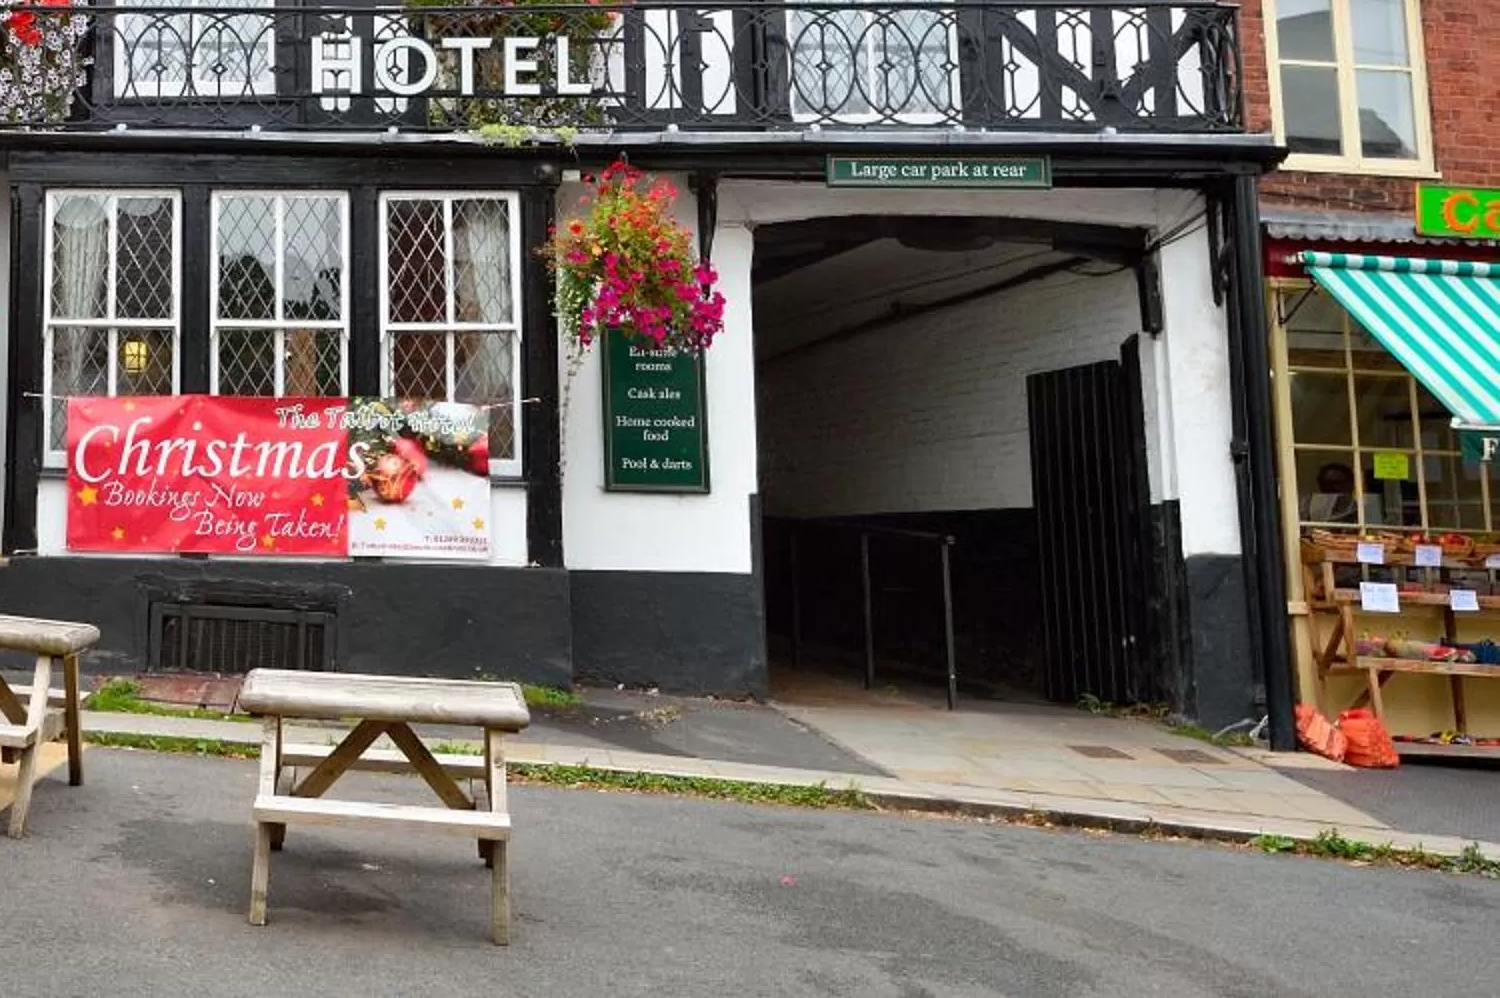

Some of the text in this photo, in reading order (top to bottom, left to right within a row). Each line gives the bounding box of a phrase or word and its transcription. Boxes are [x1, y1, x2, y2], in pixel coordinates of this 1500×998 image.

[310, 35, 594, 95] HOTEL
[851, 161, 1027, 180] Large car park at rear
[635, 362, 672, 371] rooms
[627, 387, 681, 399] Cask ales
[276, 404, 477, 434] The Talbot Hotel
[615, 415, 695, 427] Home cooked
[643, 429, 669, 441] food
[75, 416, 372, 483] Christmas
[621, 457, 693, 470] Pool & darts
[104, 478, 264, 522] Bookings Now
[194, 508, 345, 551] Being Taken!
